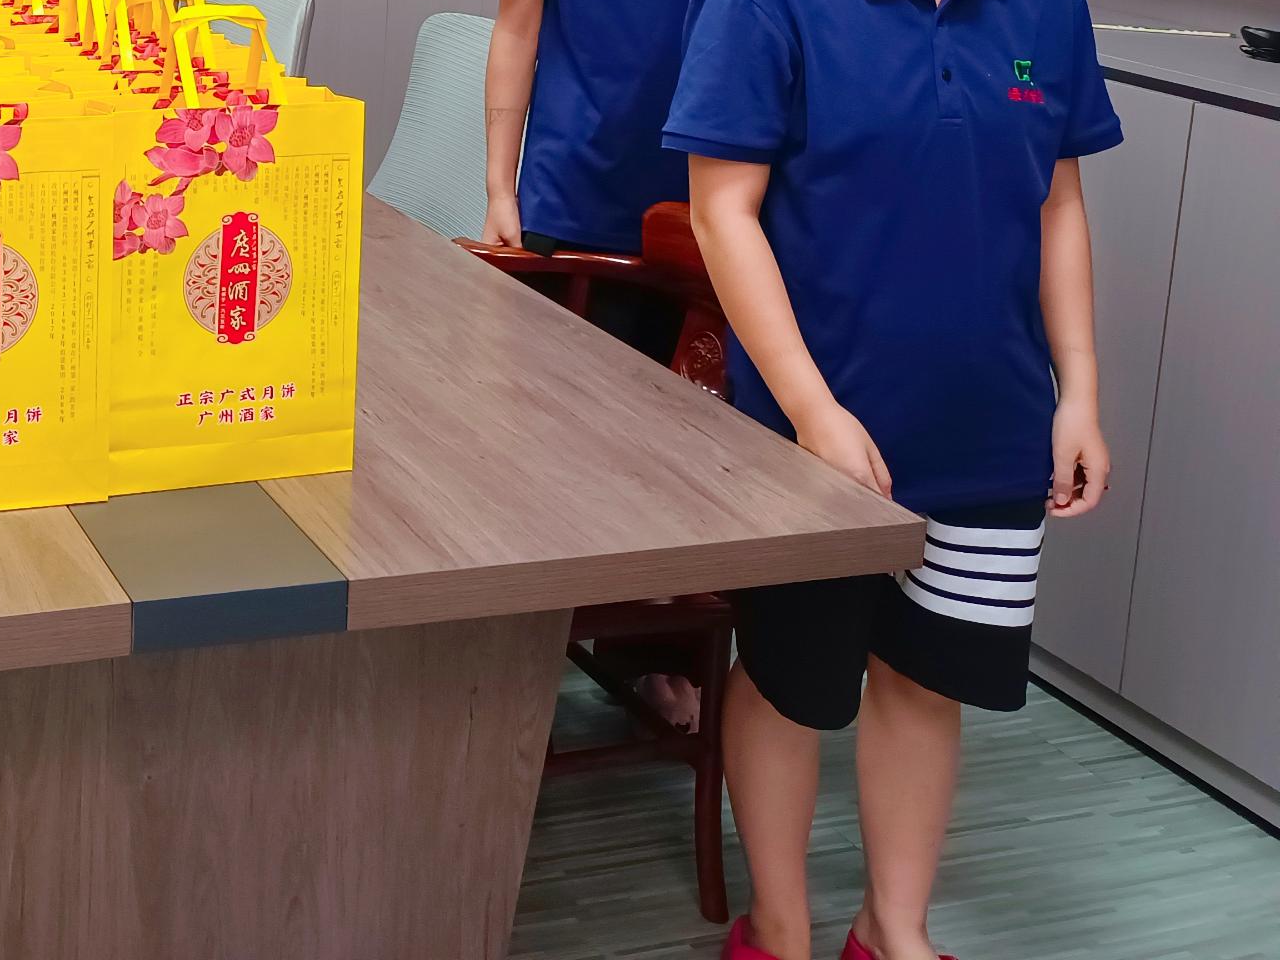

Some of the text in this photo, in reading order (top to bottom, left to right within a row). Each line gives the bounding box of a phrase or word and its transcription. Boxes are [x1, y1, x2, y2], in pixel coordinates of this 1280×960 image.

[176, 382, 296, 407] 正宗广式月饼
[198, 405, 275, 425] 广州酒家
